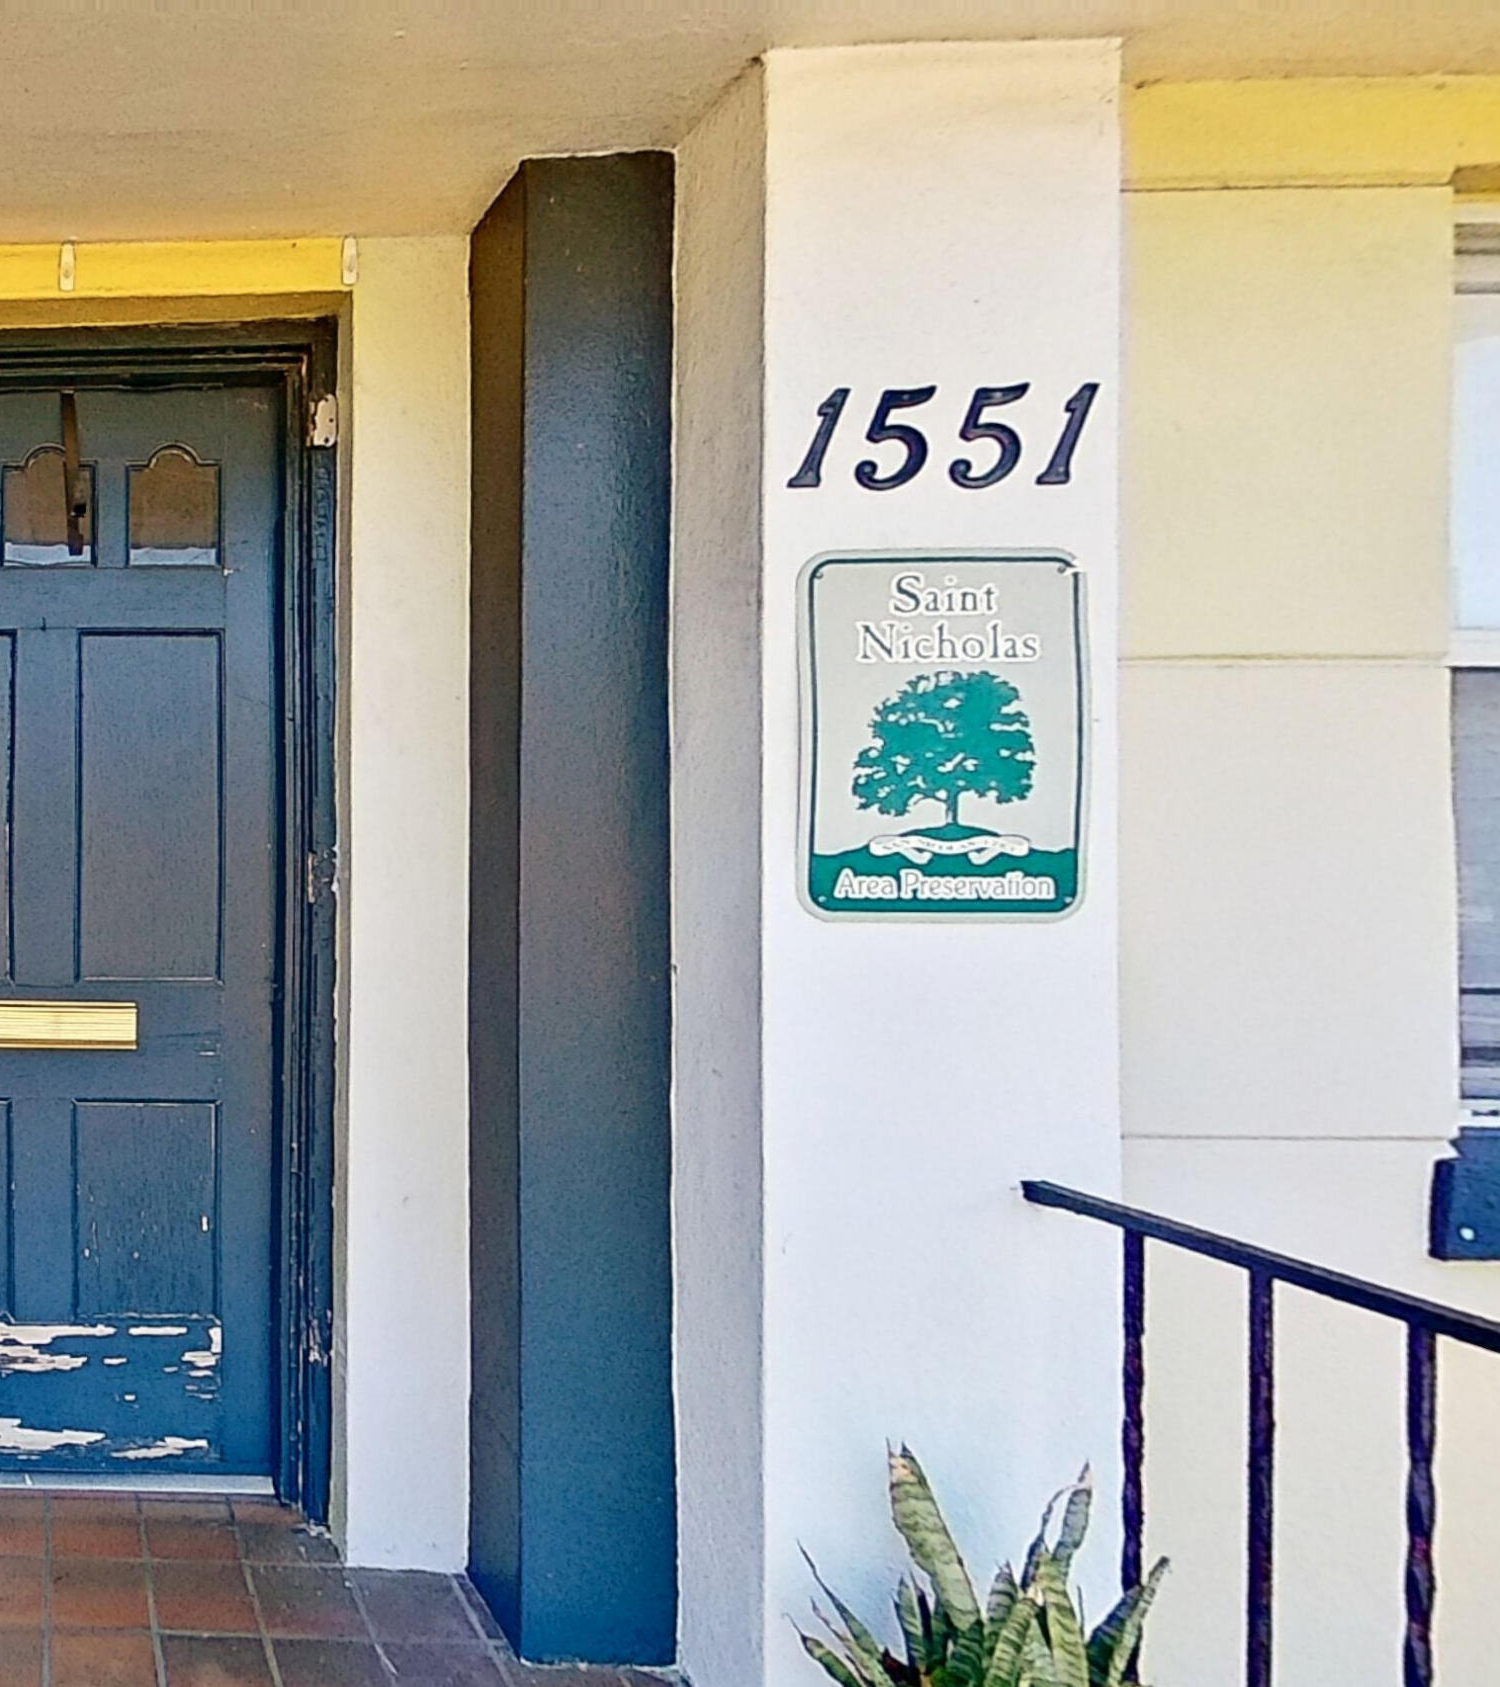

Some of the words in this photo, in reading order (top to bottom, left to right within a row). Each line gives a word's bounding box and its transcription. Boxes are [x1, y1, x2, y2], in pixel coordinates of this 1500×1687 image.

[786, 382, 1100, 491] 1551
[893, 574, 996, 613] Saint
[860, 622, 1037, 660] Nicholas
[837, 871, 895, 897] Area
[902, 871, 1053, 897] Preservation
